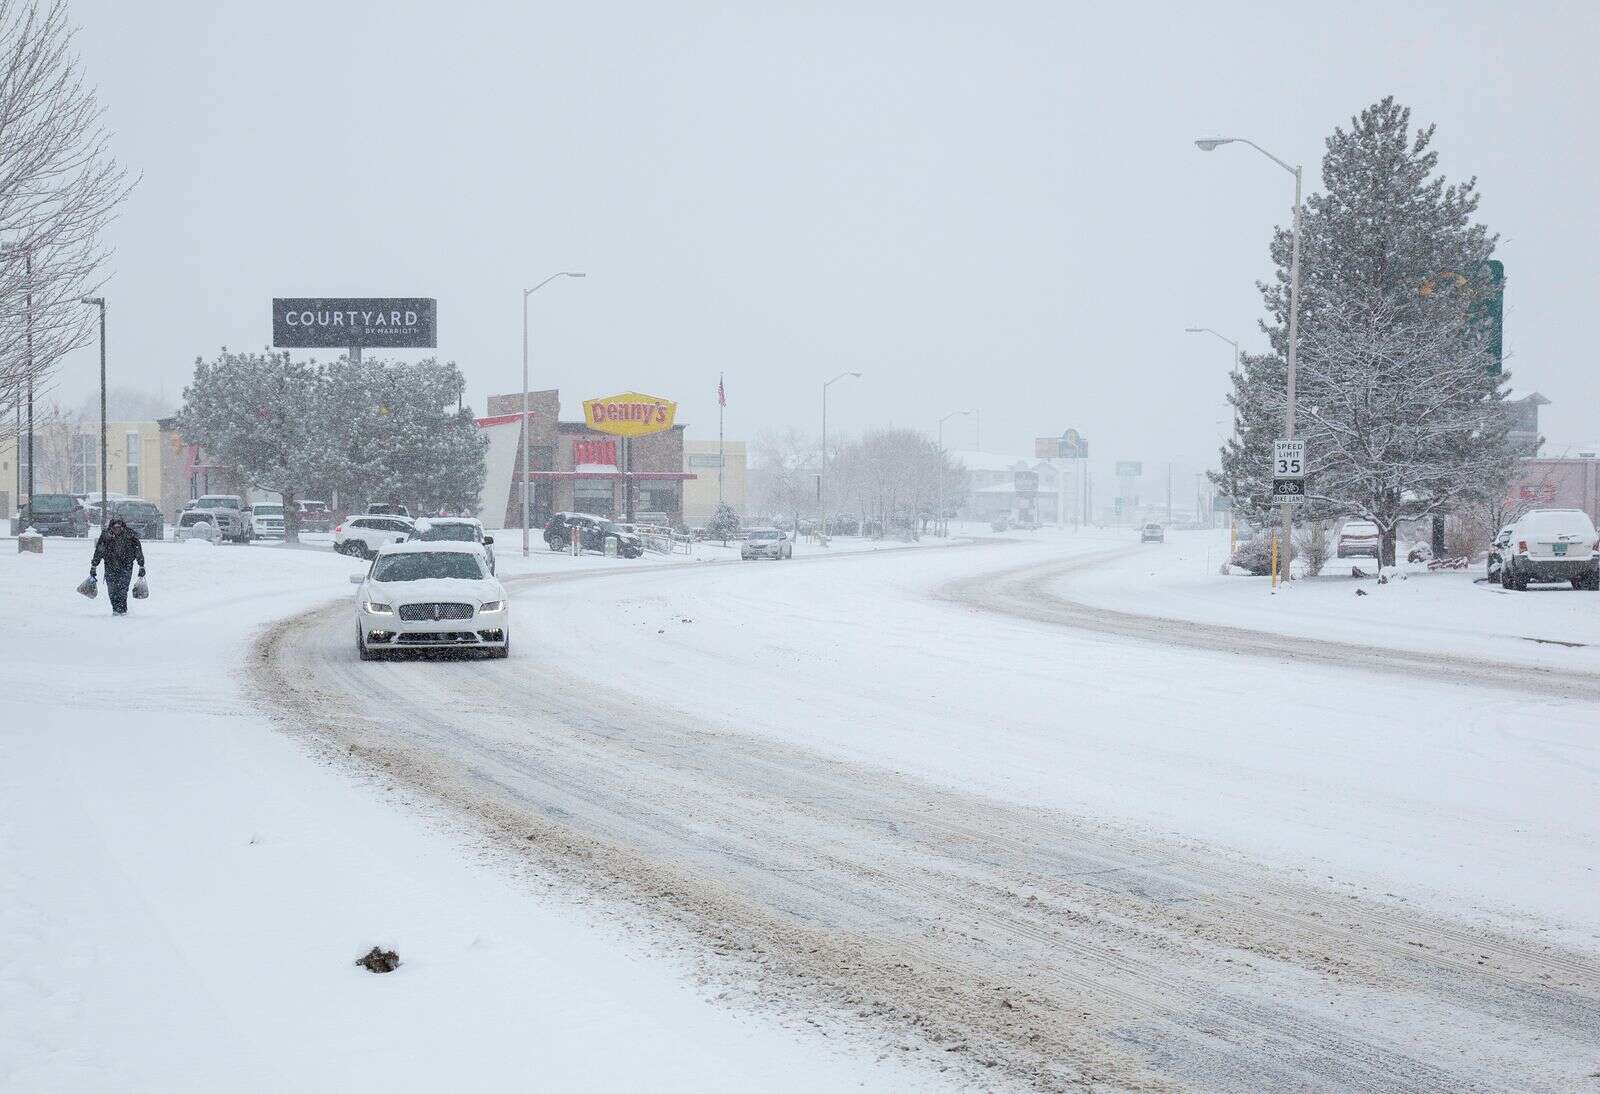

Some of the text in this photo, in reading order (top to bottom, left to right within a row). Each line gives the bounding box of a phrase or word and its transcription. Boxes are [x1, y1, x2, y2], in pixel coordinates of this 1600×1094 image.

[285, 311, 418, 326] COURTYARD
[591, 401, 667, 425] Denny's
[1278, 459, 1301, 473] 35
